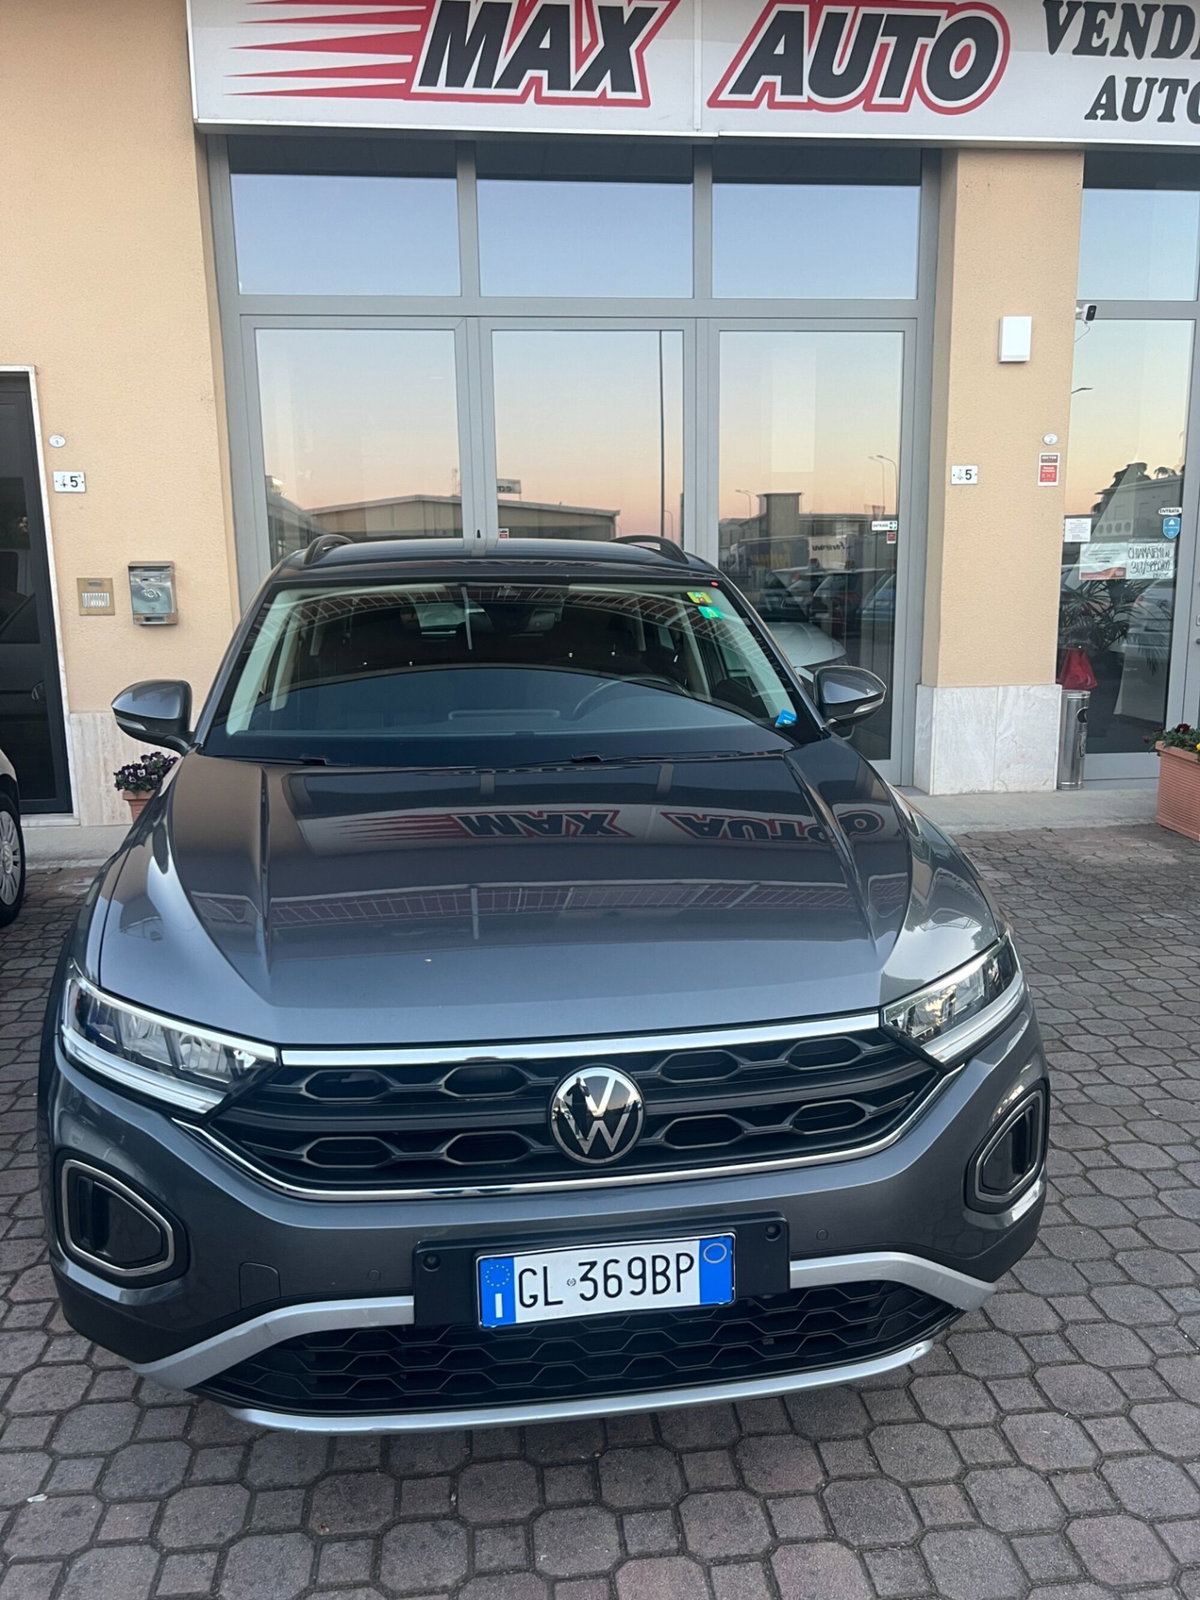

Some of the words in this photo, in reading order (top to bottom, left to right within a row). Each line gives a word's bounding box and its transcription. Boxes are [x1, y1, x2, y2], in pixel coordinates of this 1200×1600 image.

[417, 0, 660, 93] MAX
[729, 10, 999, 101] AUTO
[1043, 0, 1200, 60] VEND
[518, 1266, 564, 1309] GL
[578, 1252, 695, 1302] 369BP
